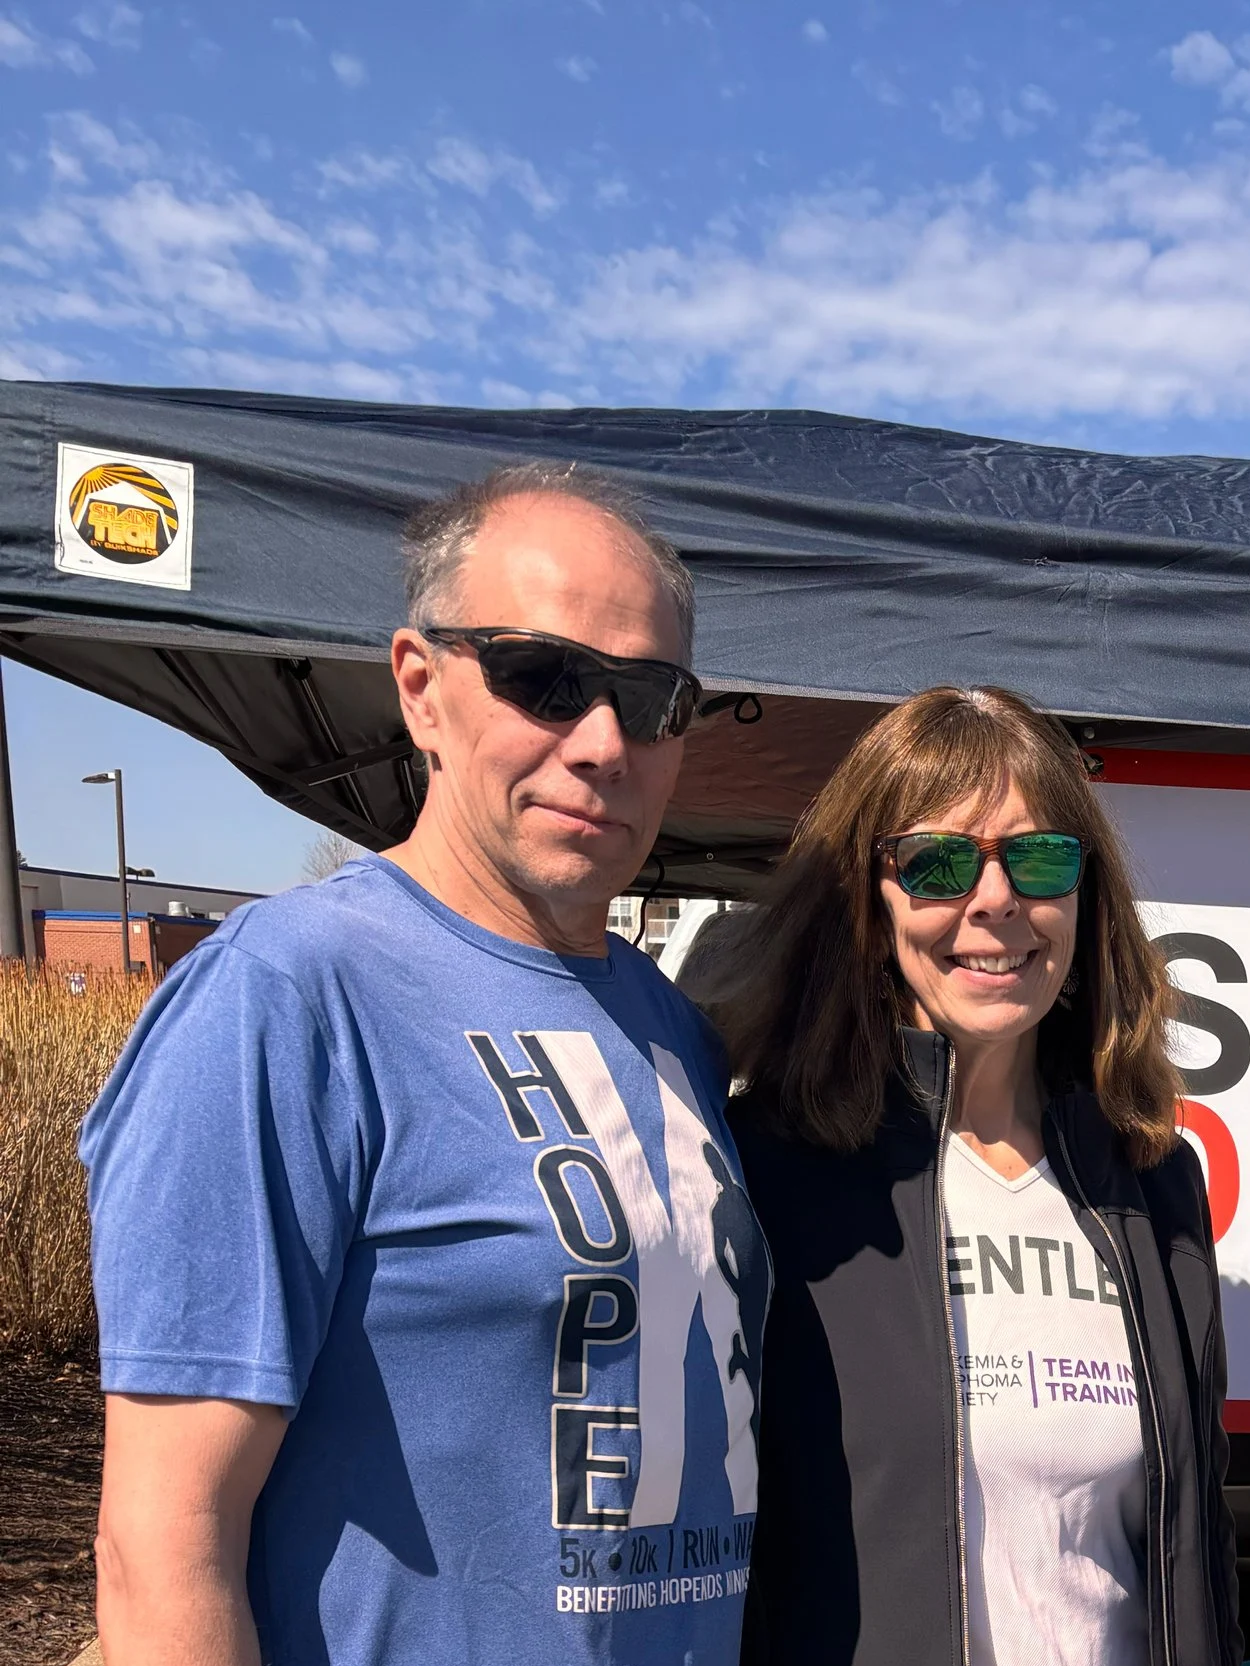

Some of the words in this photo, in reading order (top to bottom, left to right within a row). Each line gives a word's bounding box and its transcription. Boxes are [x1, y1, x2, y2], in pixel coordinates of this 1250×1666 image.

[89, 502, 158, 527] SHADE
[89, 521, 157, 549] TECH
[463, 1030, 641, 1530] HOPE
[1011, 1354, 1023, 1369] &
[1043, 1358, 1111, 1381] TEAM
[1116, 1363, 1135, 1383] IN
[683, 1525, 720, 1569] RUN
[556, 1581, 656, 1613] BENEFITTING
